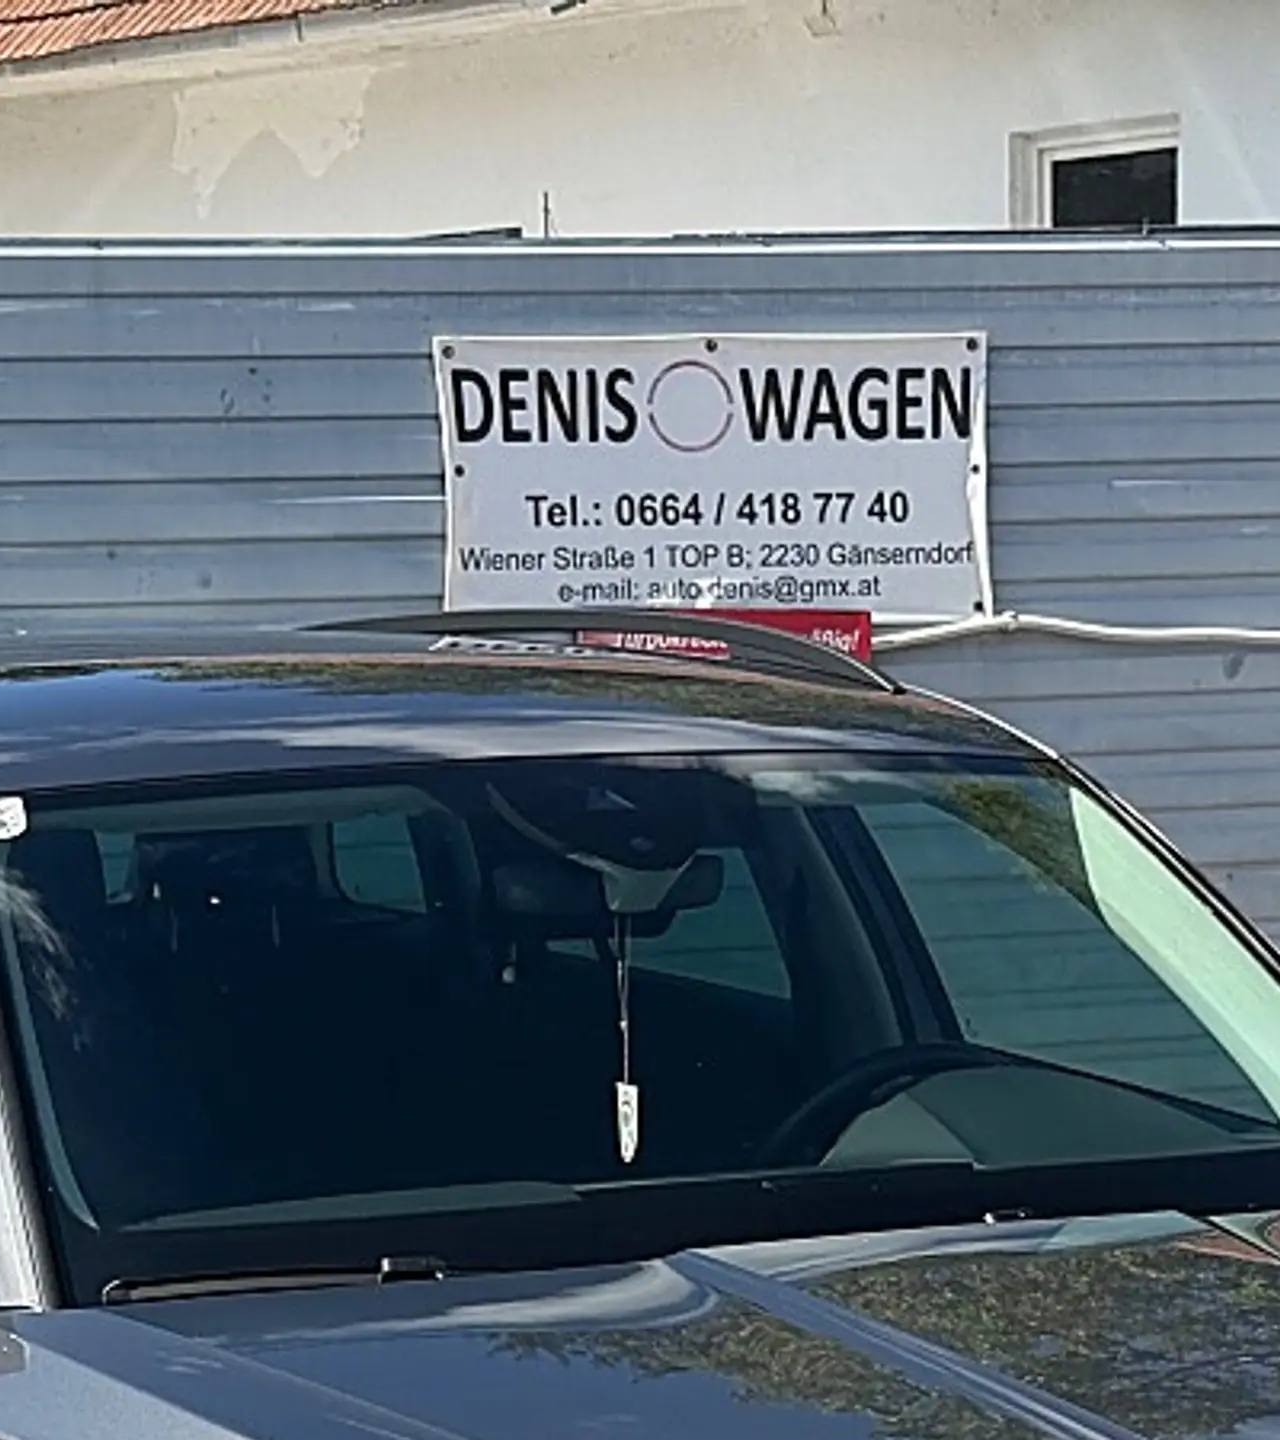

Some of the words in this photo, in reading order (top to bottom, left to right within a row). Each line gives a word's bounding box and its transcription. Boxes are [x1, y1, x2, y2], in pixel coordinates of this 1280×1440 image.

[451, 367, 638, 442] DENIS
[739, 367, 971, 441] WAGEN
[524, 494, 603, 528] Tel.:
[616, 492, 703, 527] 0664
[713, 491, 726, 526] /
[736, 491, 802, 526] 418
[813, 491, 856, 524] 77
[867, 489, 909, 523] 40
[459, 546, 546, 572] Wiener
[552, 545, 636, 572] Straße
[644, 545, 656, 568] 1
[665, 543, 719, 569] TOP
[726, 543, 753, 570] B;
[759, 542, 820, 569] 2230
[826, 539, 974, 566] Gänserndorf
[557, 576, 641, 603] e-mail:
